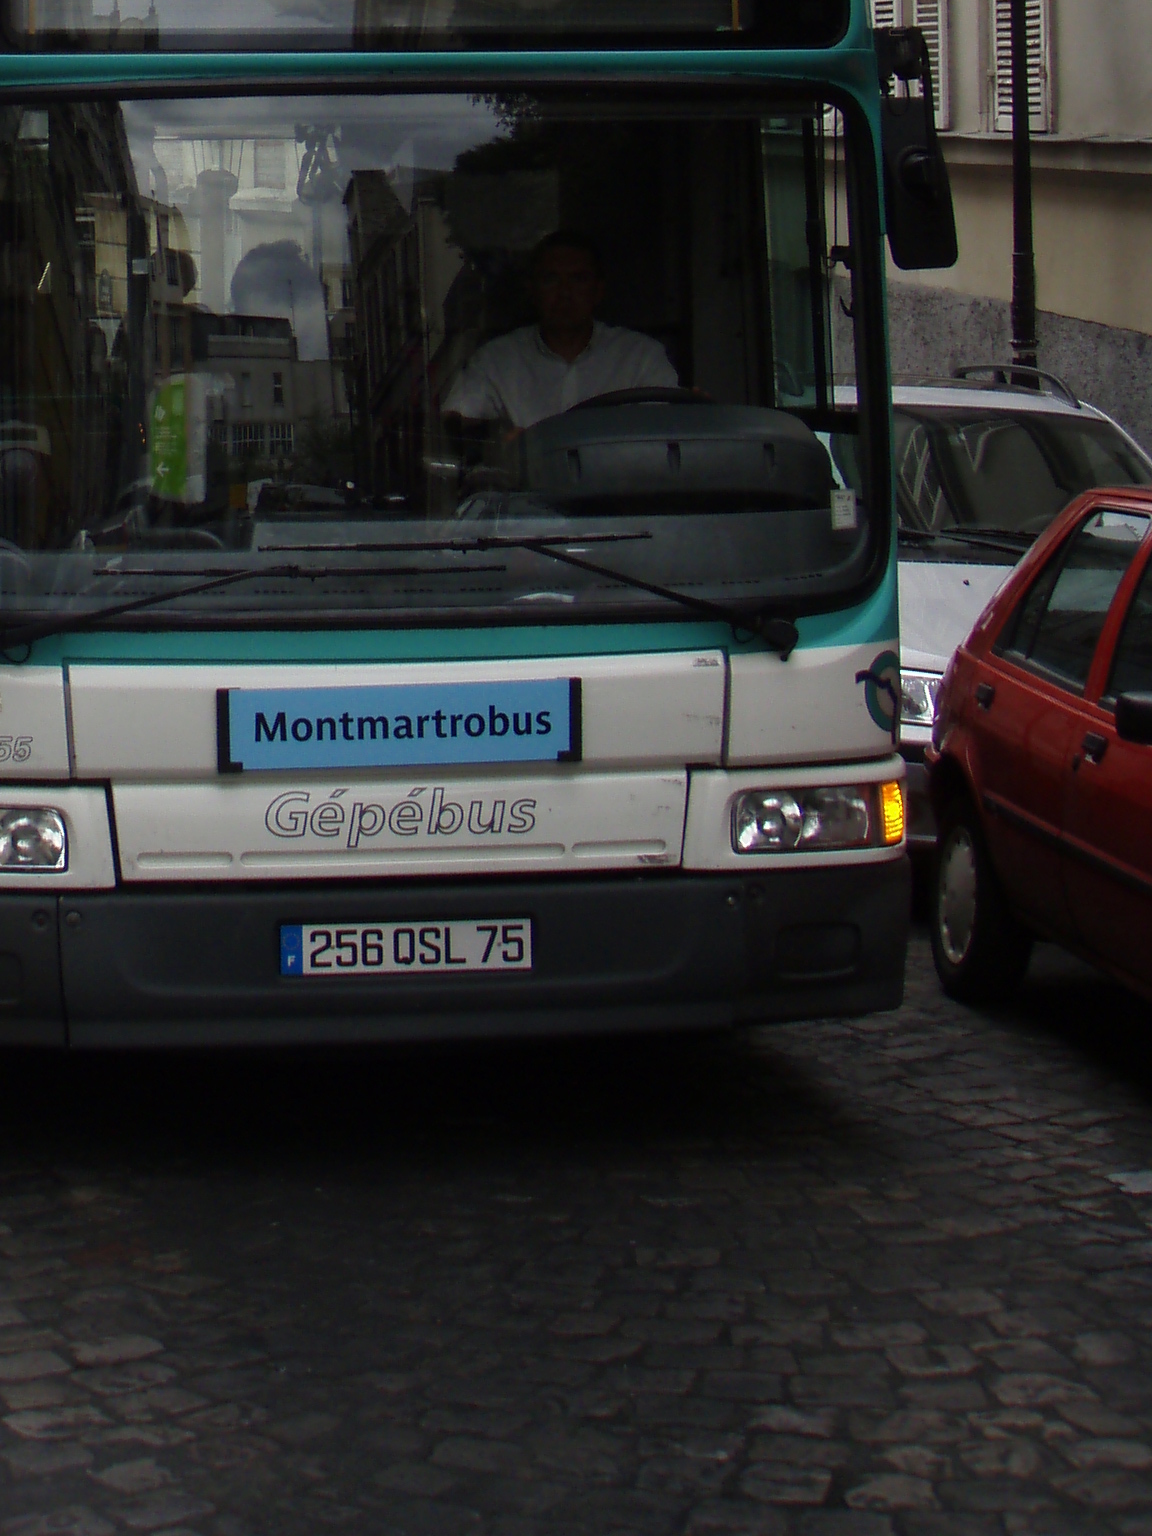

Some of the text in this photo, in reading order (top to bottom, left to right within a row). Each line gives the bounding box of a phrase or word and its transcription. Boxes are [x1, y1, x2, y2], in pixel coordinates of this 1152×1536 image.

[254, 704, 552, 743] Montmartrobus
[264, 786, 537, 849] Gépébus
[309, 929, 384, 968] 256
[393, 926, 467, 966] QSL
[476, 923, 525, 964] 75
